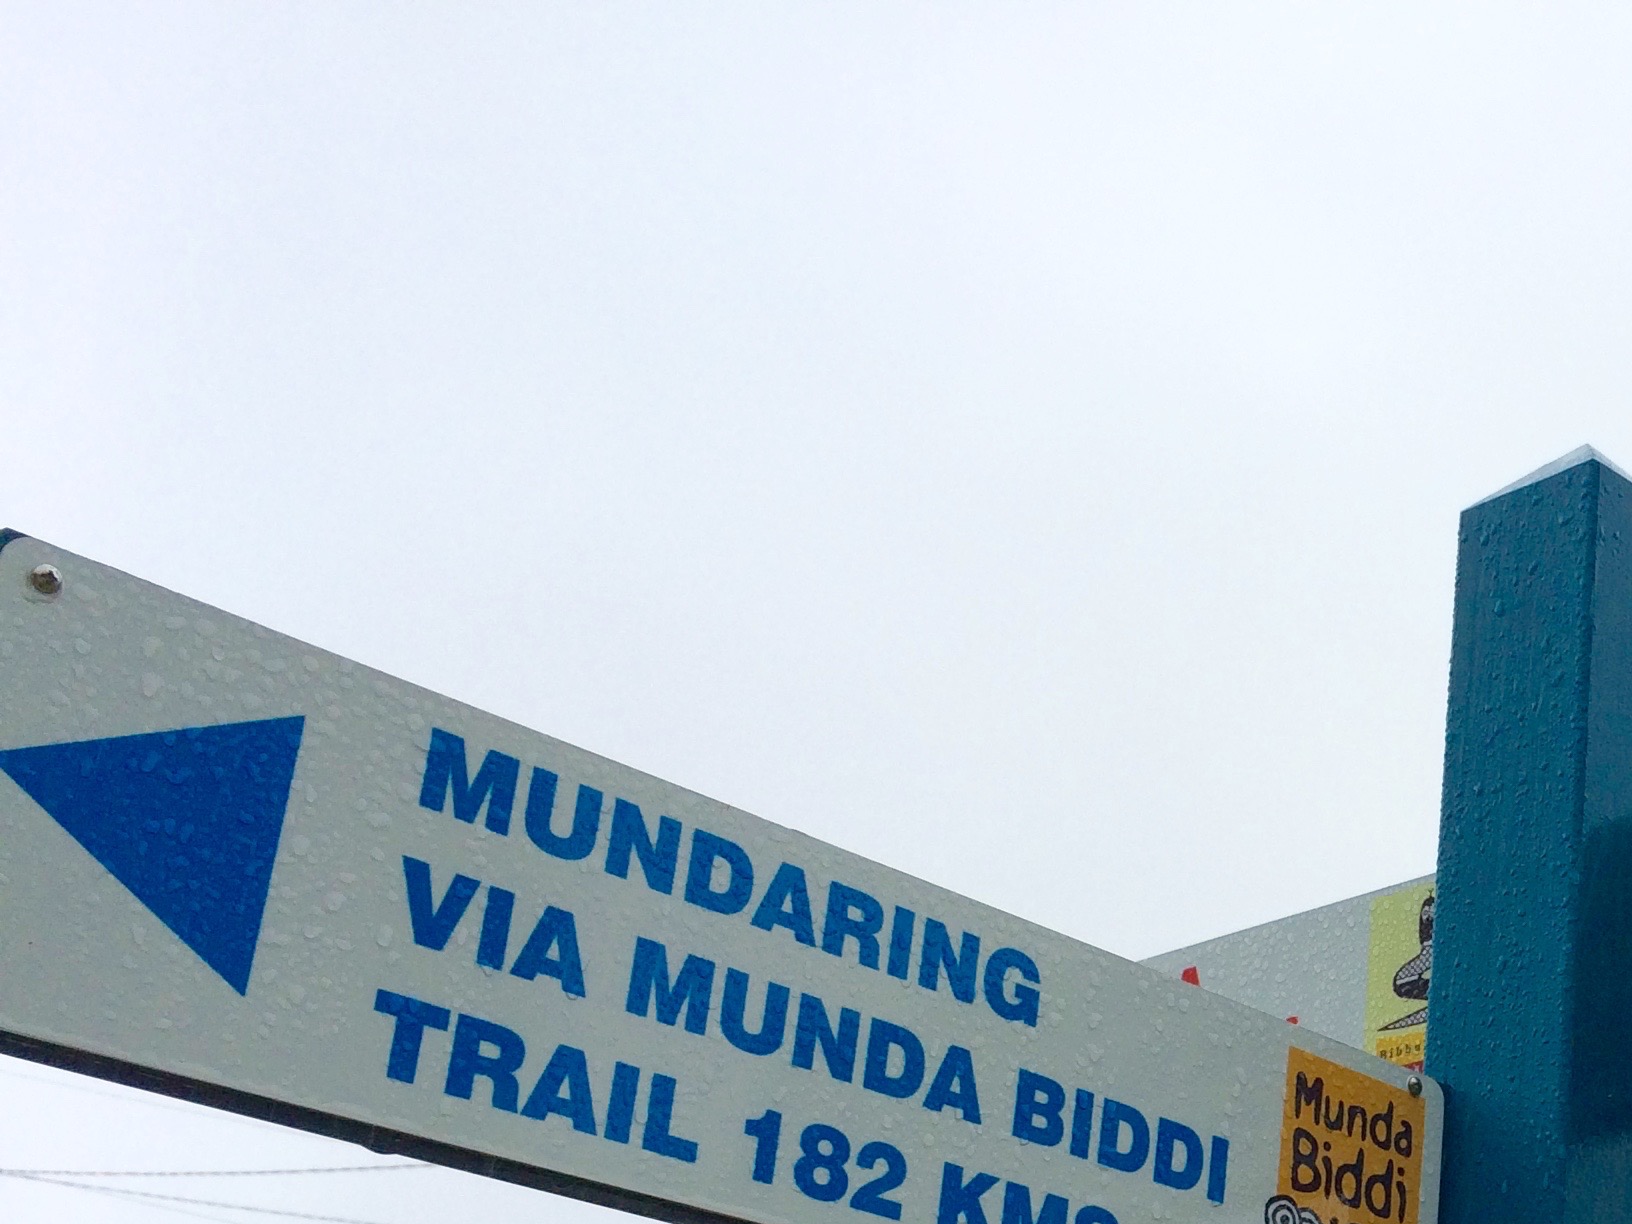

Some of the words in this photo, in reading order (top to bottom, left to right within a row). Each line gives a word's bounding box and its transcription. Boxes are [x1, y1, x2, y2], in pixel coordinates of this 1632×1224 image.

[418, 727, 1040, 1027] MUNDARING
[373, 989, 698, 1163] TRAIL
[743, 1109, 907, 1221] 182
[402, 856, 586, 998] VIA
[625, 936, 982, 1124] MUNDA
[1011, 1068, 1229, 1204] BIDDI
[1294, 1071, 1413, 1158] Munda
[1290, 1127, 1407, 1224] Biddi
